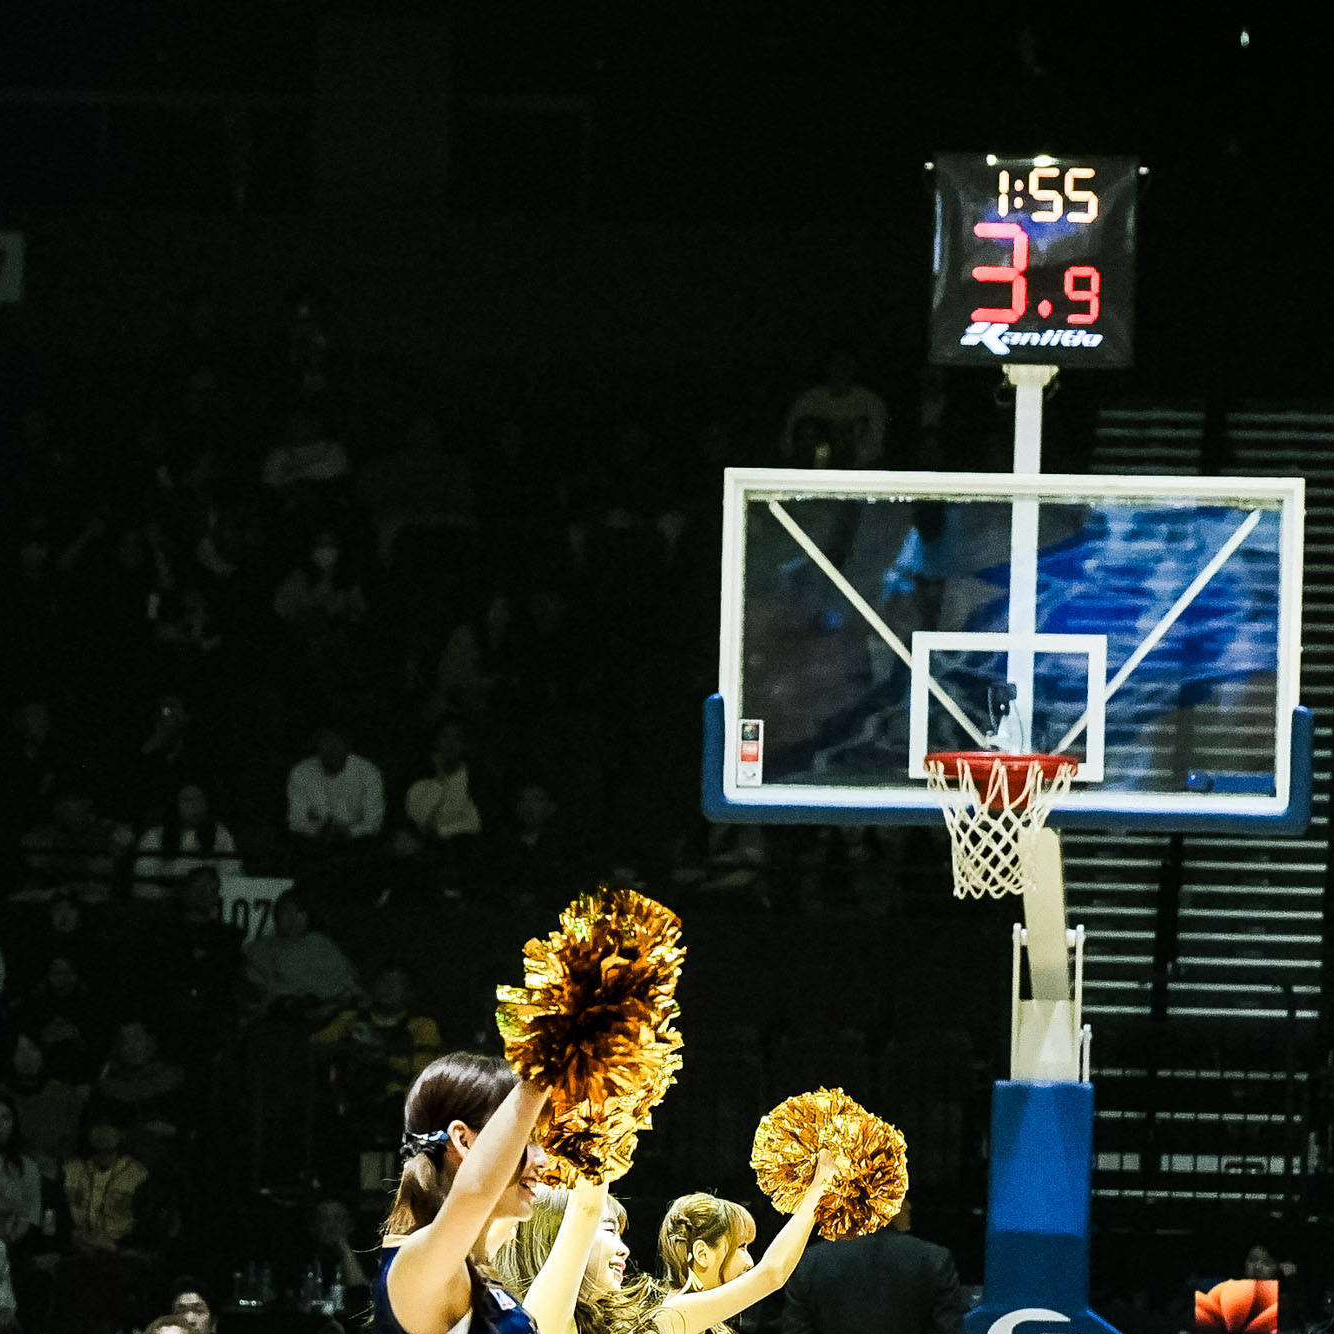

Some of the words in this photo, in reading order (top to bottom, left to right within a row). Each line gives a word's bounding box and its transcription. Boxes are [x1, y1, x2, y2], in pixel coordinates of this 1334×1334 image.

[997, 167, 1099, 223] 1:55
[970, 222, 1101, 324] 3.9
[233, 899, 272, 937] 07
